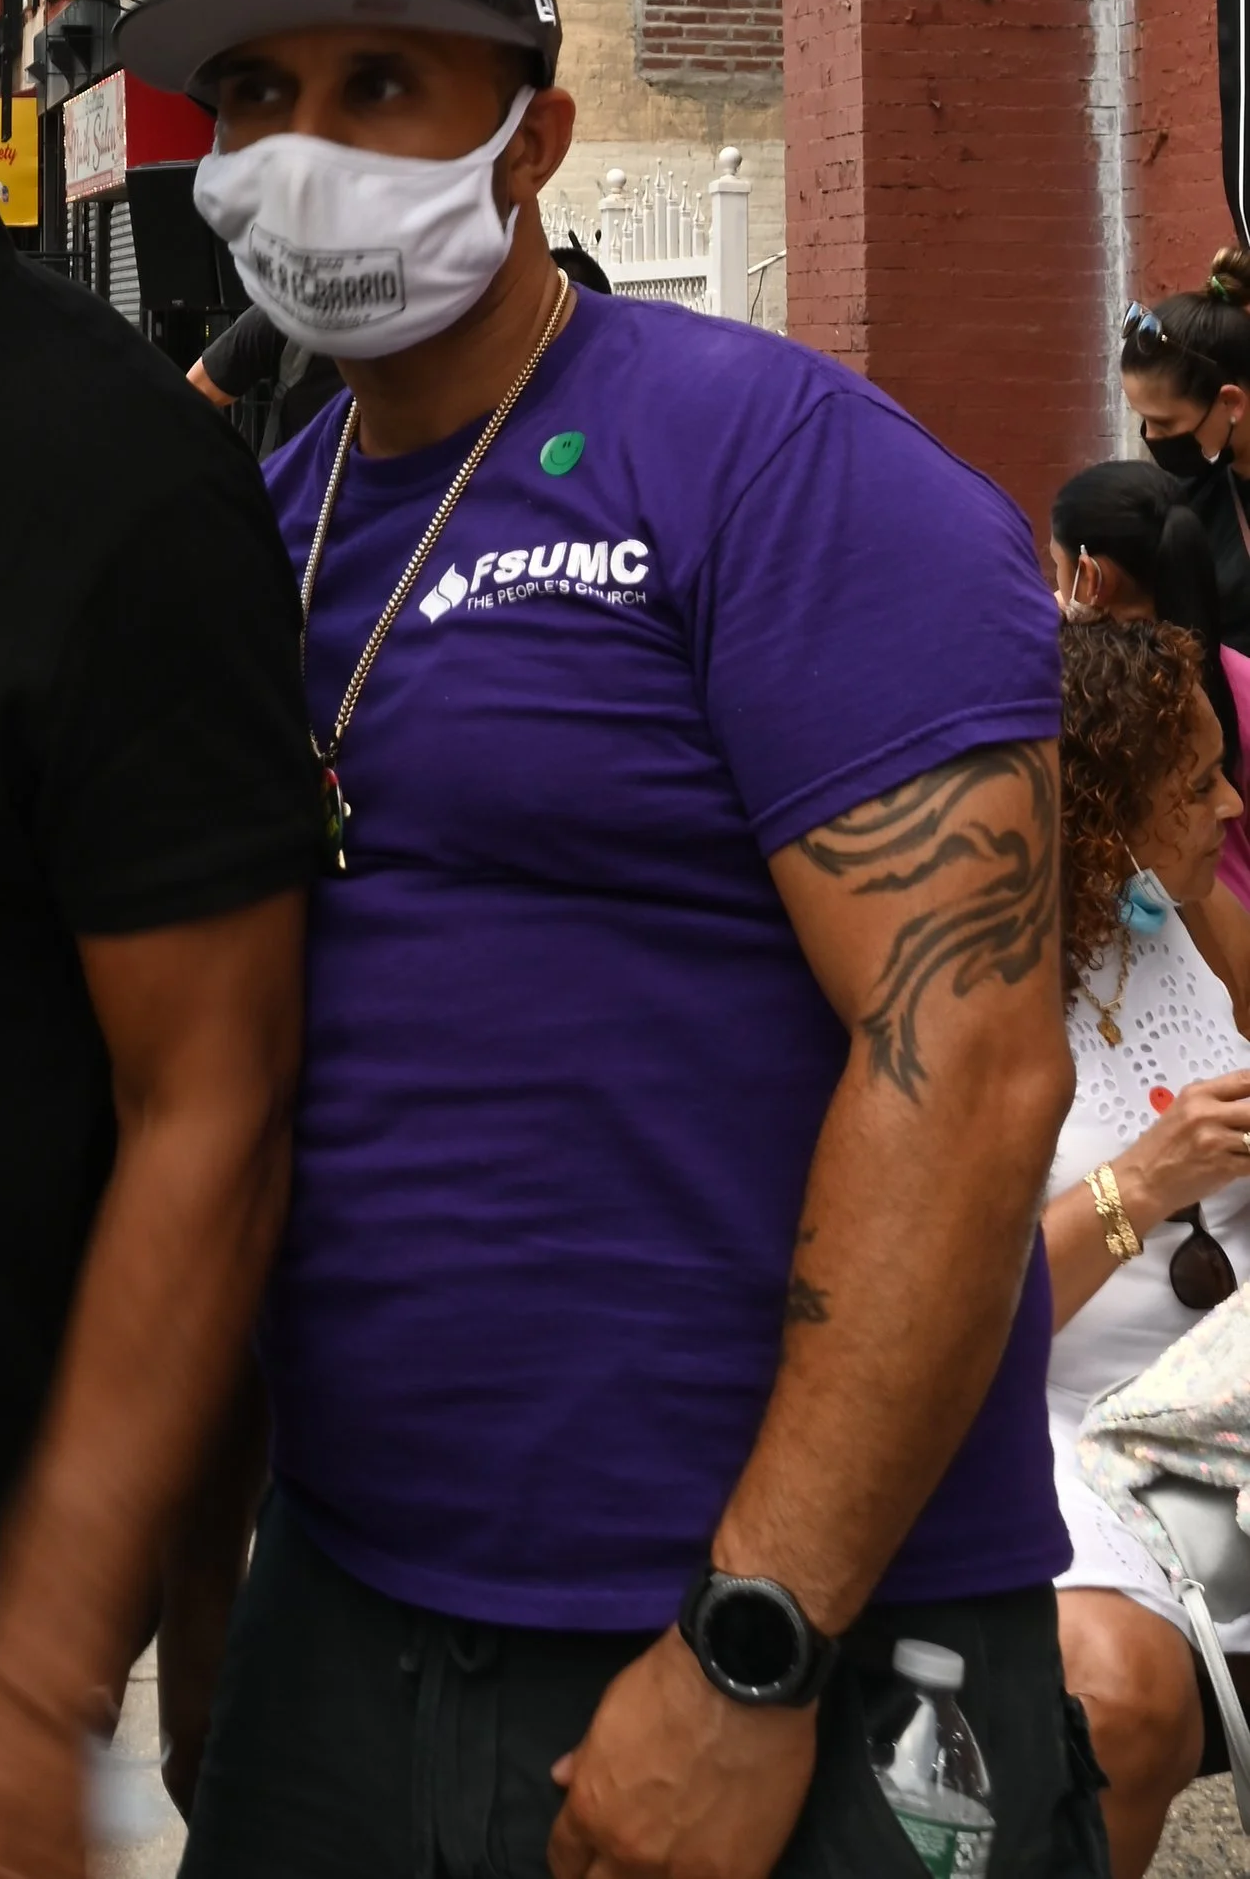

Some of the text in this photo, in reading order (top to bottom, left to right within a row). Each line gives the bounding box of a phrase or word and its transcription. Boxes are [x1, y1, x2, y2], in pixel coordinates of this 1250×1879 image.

[314, 270, 397, 312] BARRIO
[470, 538, 649, 594] FSUMC
[467, 579, 647, 611] THE PEOPLE'S CHURCH
